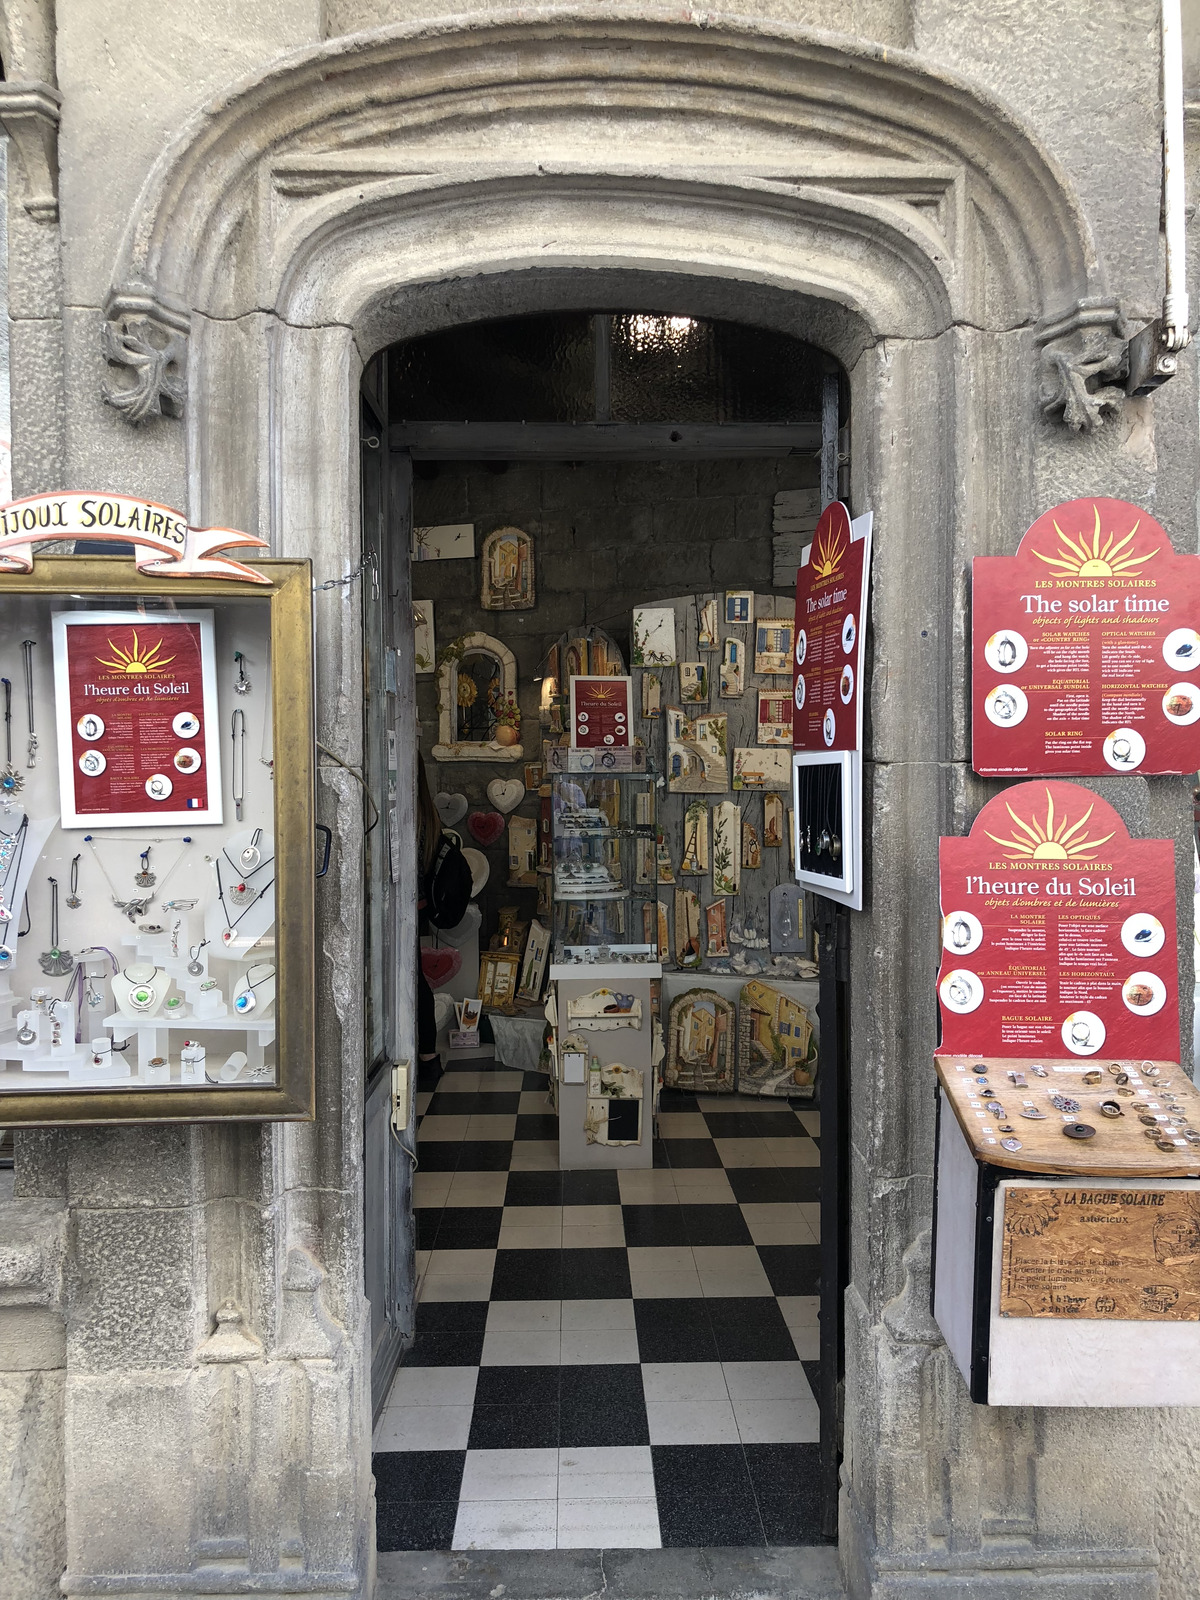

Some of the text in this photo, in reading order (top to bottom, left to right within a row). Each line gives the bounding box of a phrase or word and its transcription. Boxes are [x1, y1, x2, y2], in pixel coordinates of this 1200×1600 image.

[0, 501, 68, 536] IJOUX
[1035, 580, 1156, 588] LES MONTRES SOLAIRES
[806, 587, 847, 613] The solar time
[1020, 594, 1169, 613] The solar time
[1033, 616, 1159, 629] objects of lights and shadows
[84, 682, 189, 696] l'heure du Soleil
[989, 862, 1113, 871] LES MONTRES SOLAIRES
[966, 876, 1136, 896] l'heure du Soleil
[985, 898, 1119, 908] objets d'ombres et de lumières
[1064, 1193, 1165, 1206] LA BAGUE SOLAIRE
[1080, 1215, 1129, 1223] astucieux
